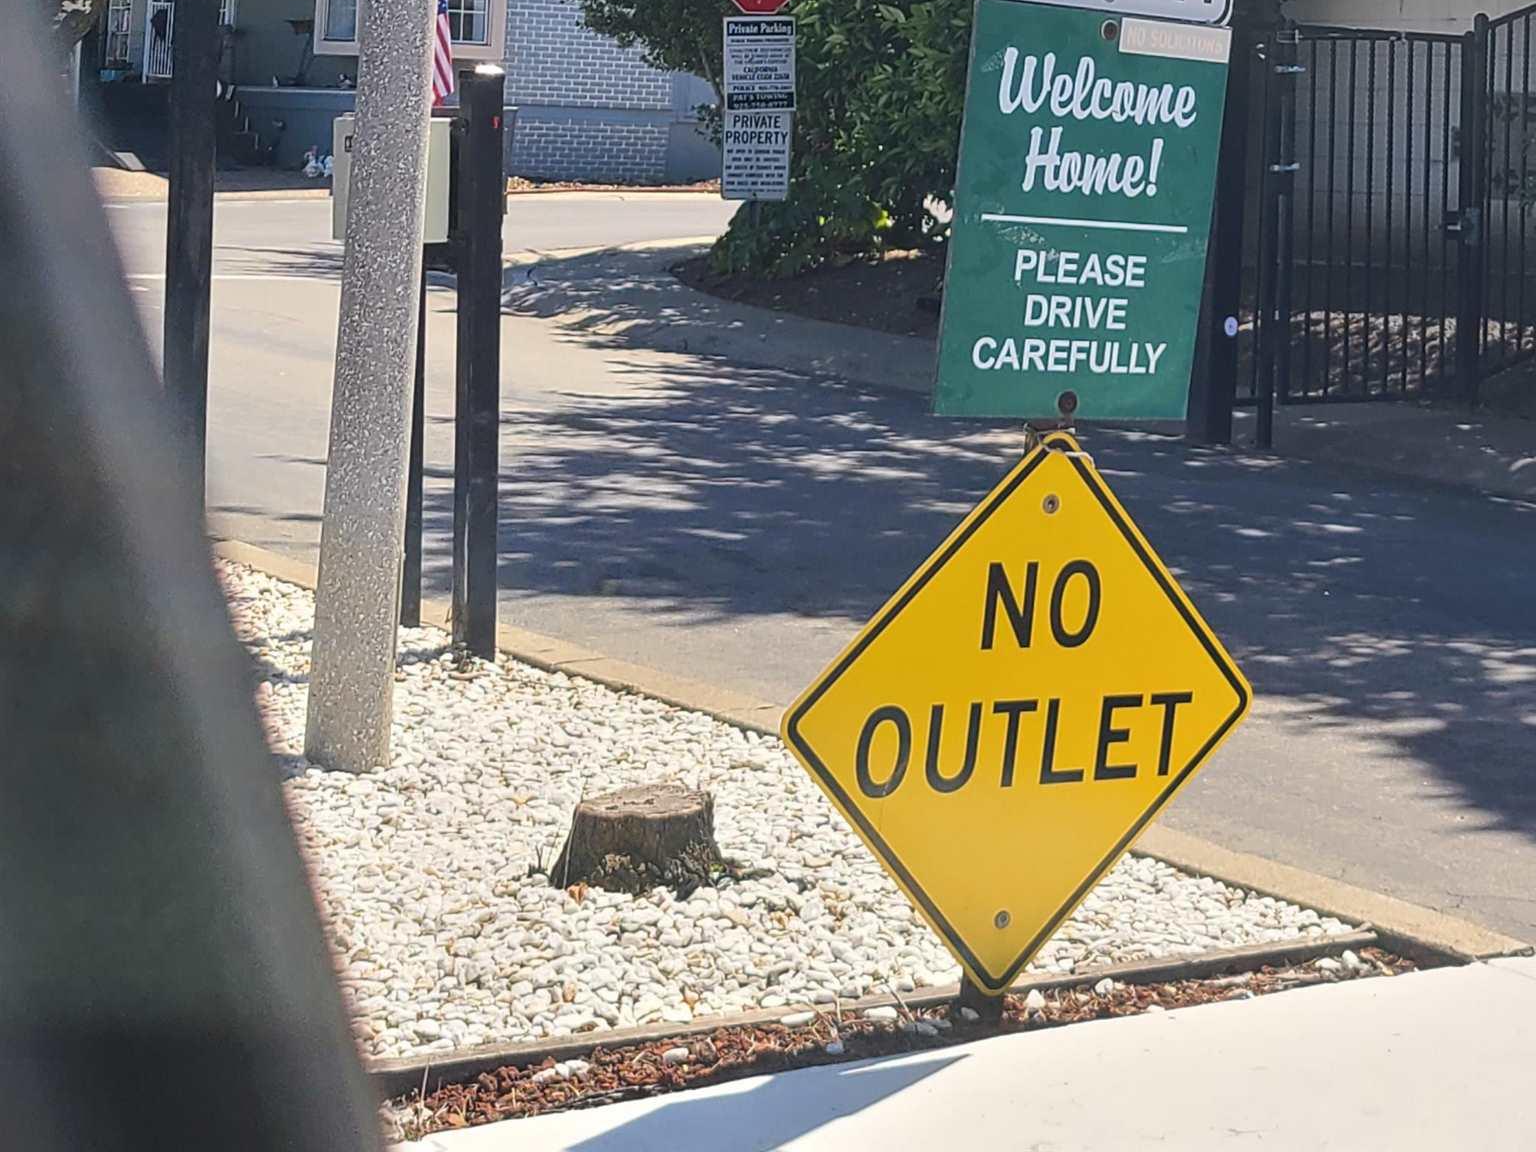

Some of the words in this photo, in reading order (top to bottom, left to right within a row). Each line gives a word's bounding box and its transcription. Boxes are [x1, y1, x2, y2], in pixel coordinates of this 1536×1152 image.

[728, 23, 759, 34] Private
[760, 22, 792, 36] Parking
[998, 46, 1197, 128] Welcome
[725, 130, 788, 145] PROPERTY
[733, 114, 781, 129] PRIVATE
[1022, 126, 1164, 198] Home!
[1014, 249, 1147, 288] PLEASE
[1024, 294, 1128, 330] DRIVE
[972, 337, 1167, 375] CAREFULLY
[980, 559, 1101, 650] NO
[855, 691, 1193, 799] OUTLET
